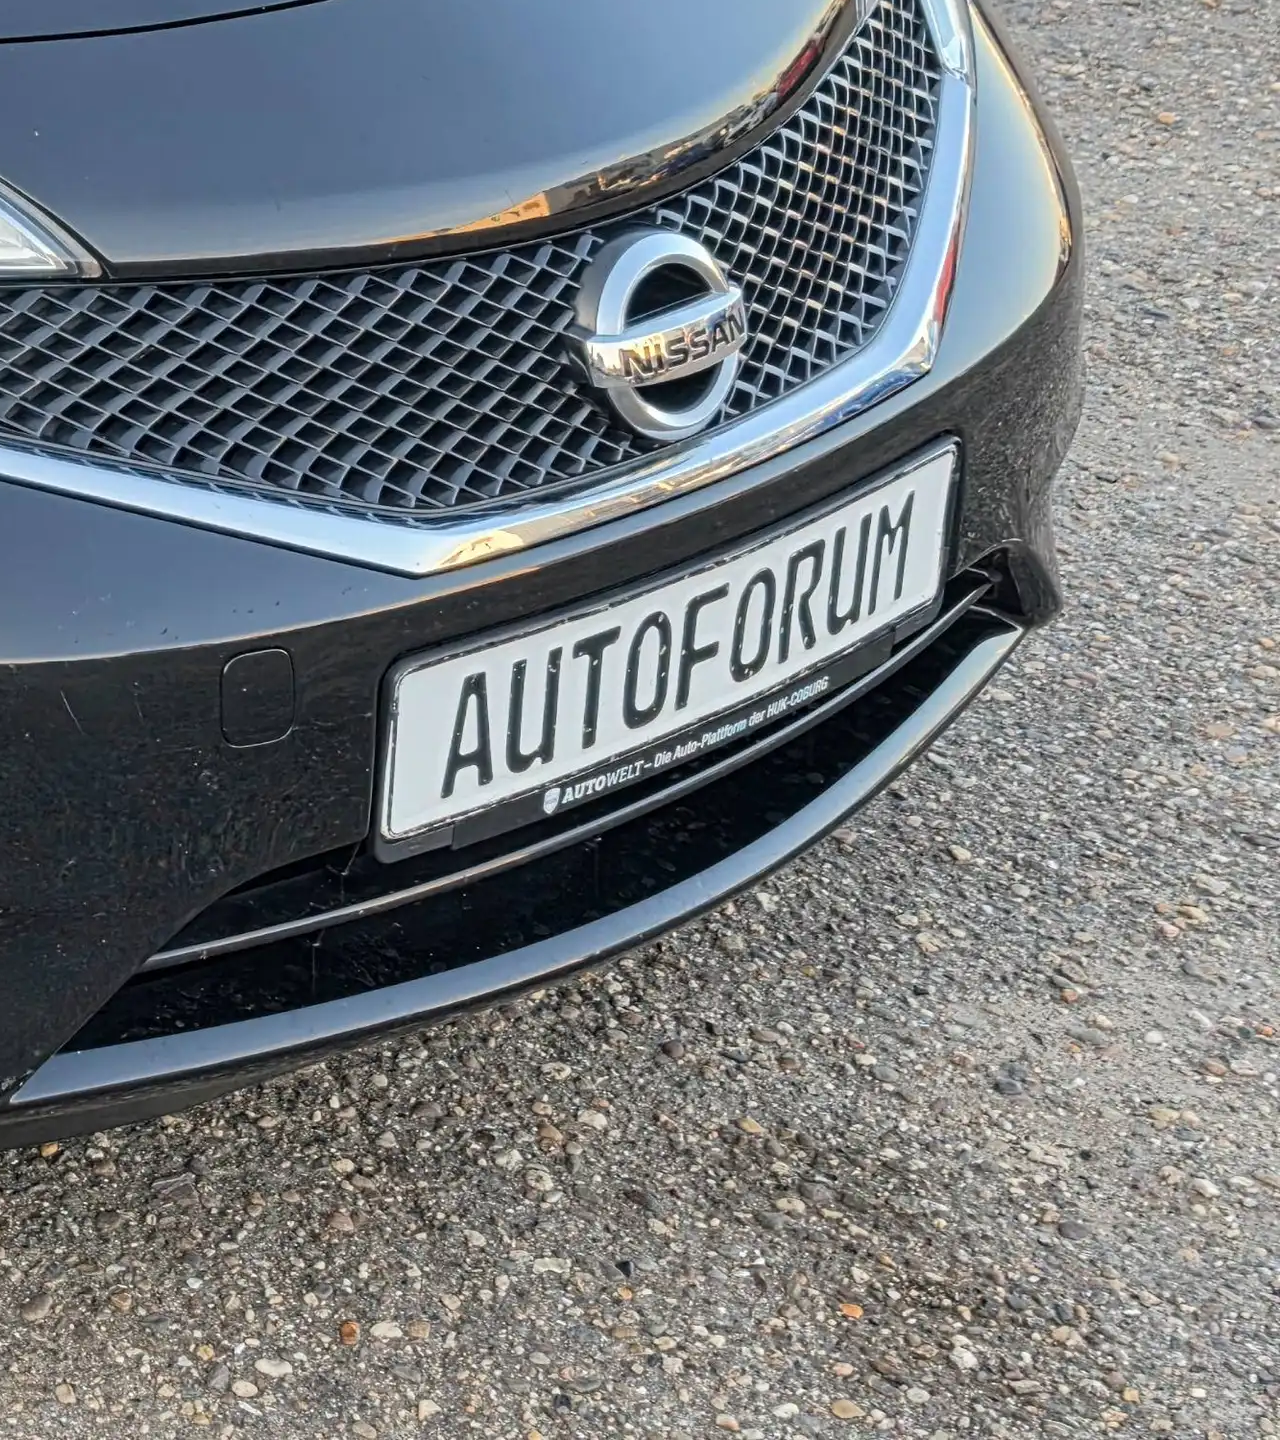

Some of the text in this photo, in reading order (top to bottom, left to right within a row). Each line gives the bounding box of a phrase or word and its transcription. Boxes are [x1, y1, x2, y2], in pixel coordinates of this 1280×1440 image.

[618, 309, 745, 378] NISSAN
[441, 489, 916, 799] AUTOFORUM
[561, 759, 645, 804] AUTOWELT
[654, 750, 671, 768] Die
[672, 718, 747, 760] Auto-Plattform
[748, 709, 767, 727] der
[766, 676, 830, 719] HUK-COBURG
